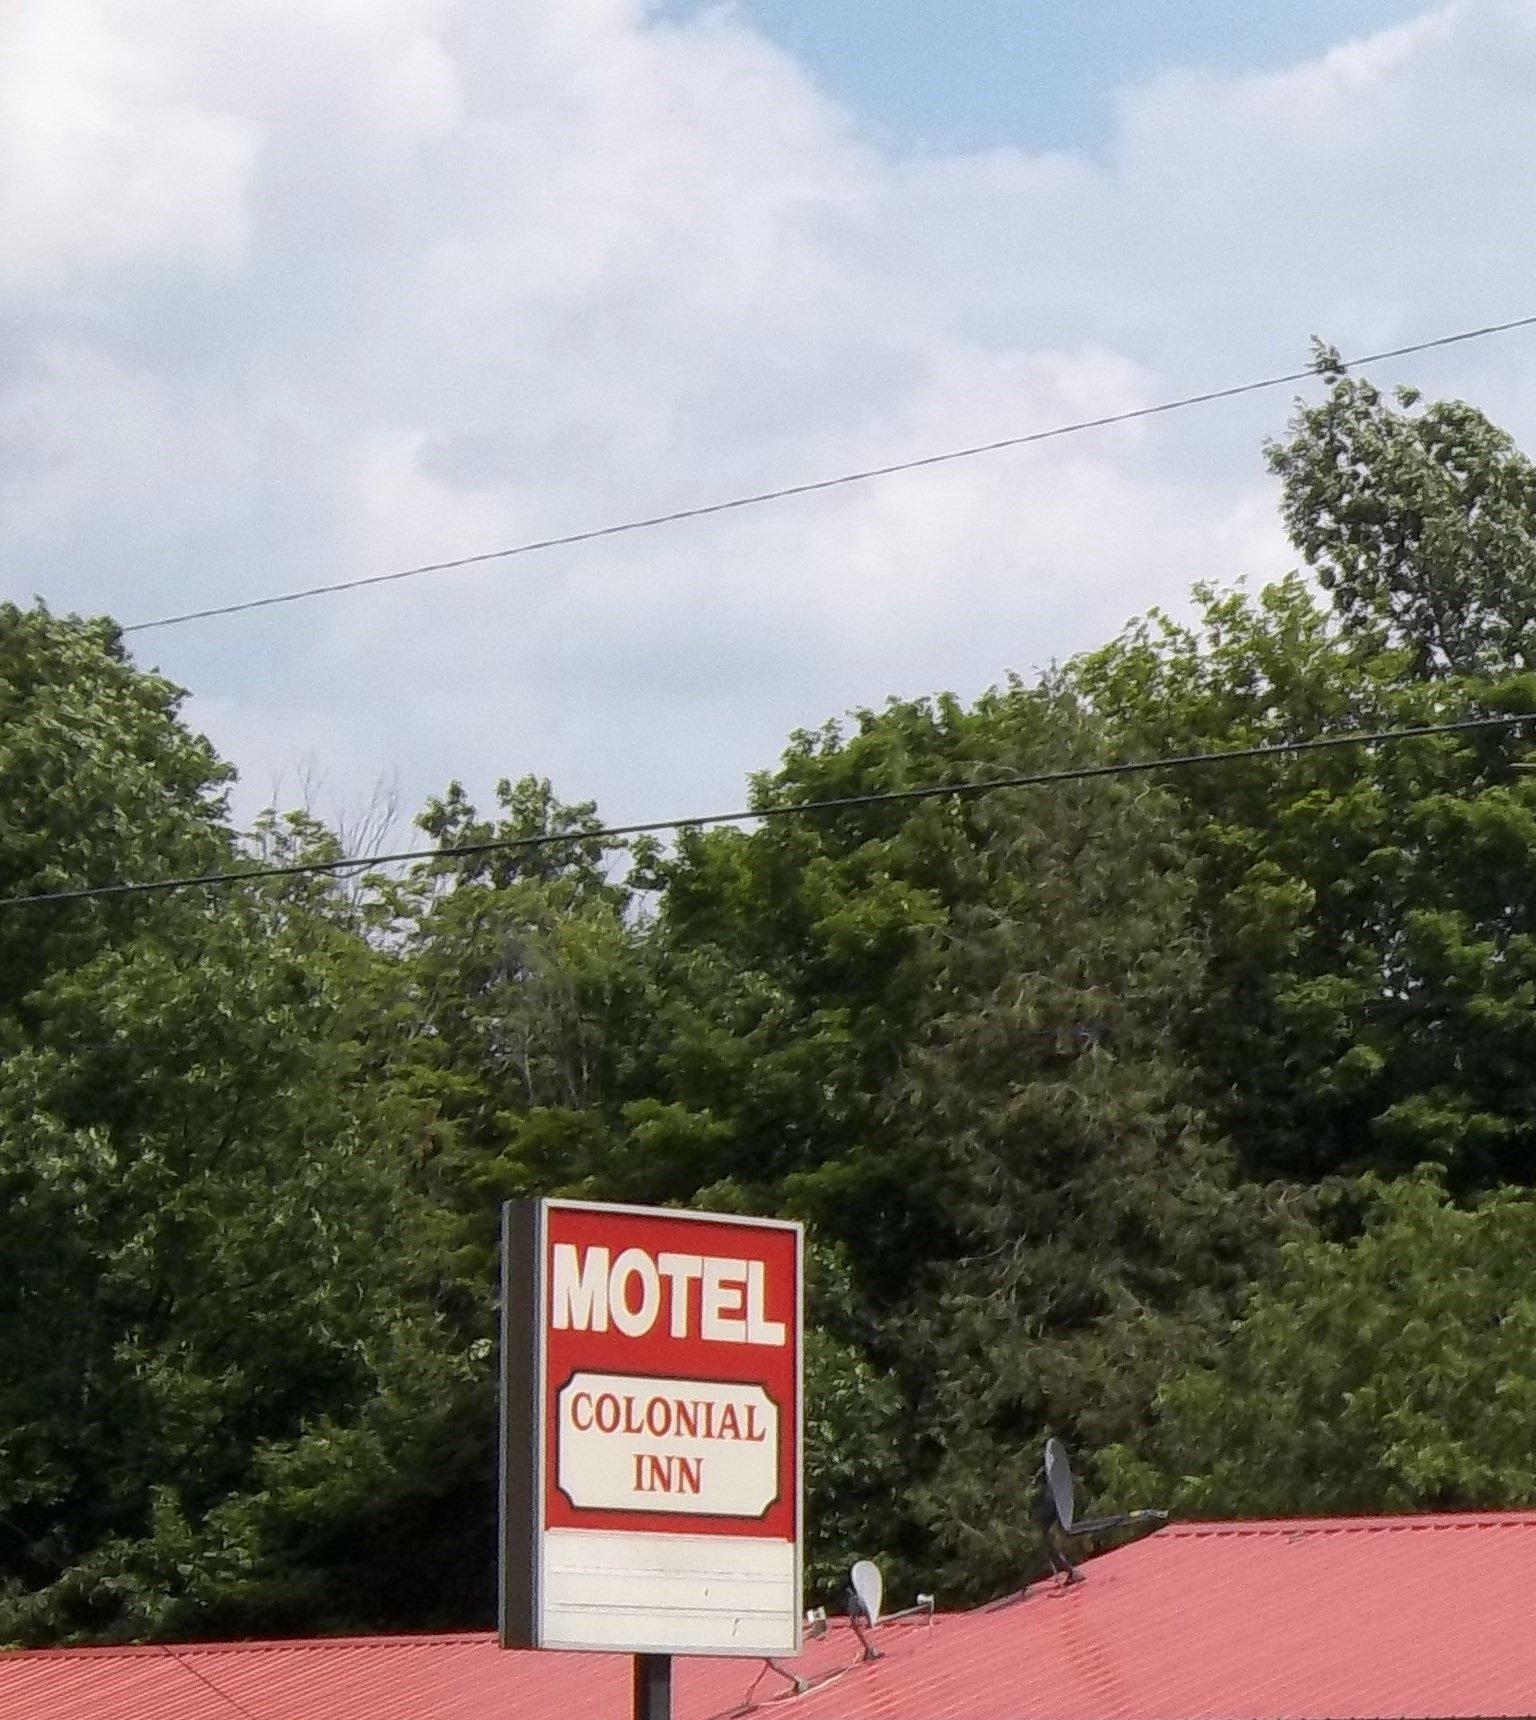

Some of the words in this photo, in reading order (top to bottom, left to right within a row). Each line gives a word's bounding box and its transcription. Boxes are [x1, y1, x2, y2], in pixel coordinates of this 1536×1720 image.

[552, 1242, 786, 1347] MOTEL
[571, 1391, 767, 1442] COLONIAL
[632, 1453, 704, 1494] INN
